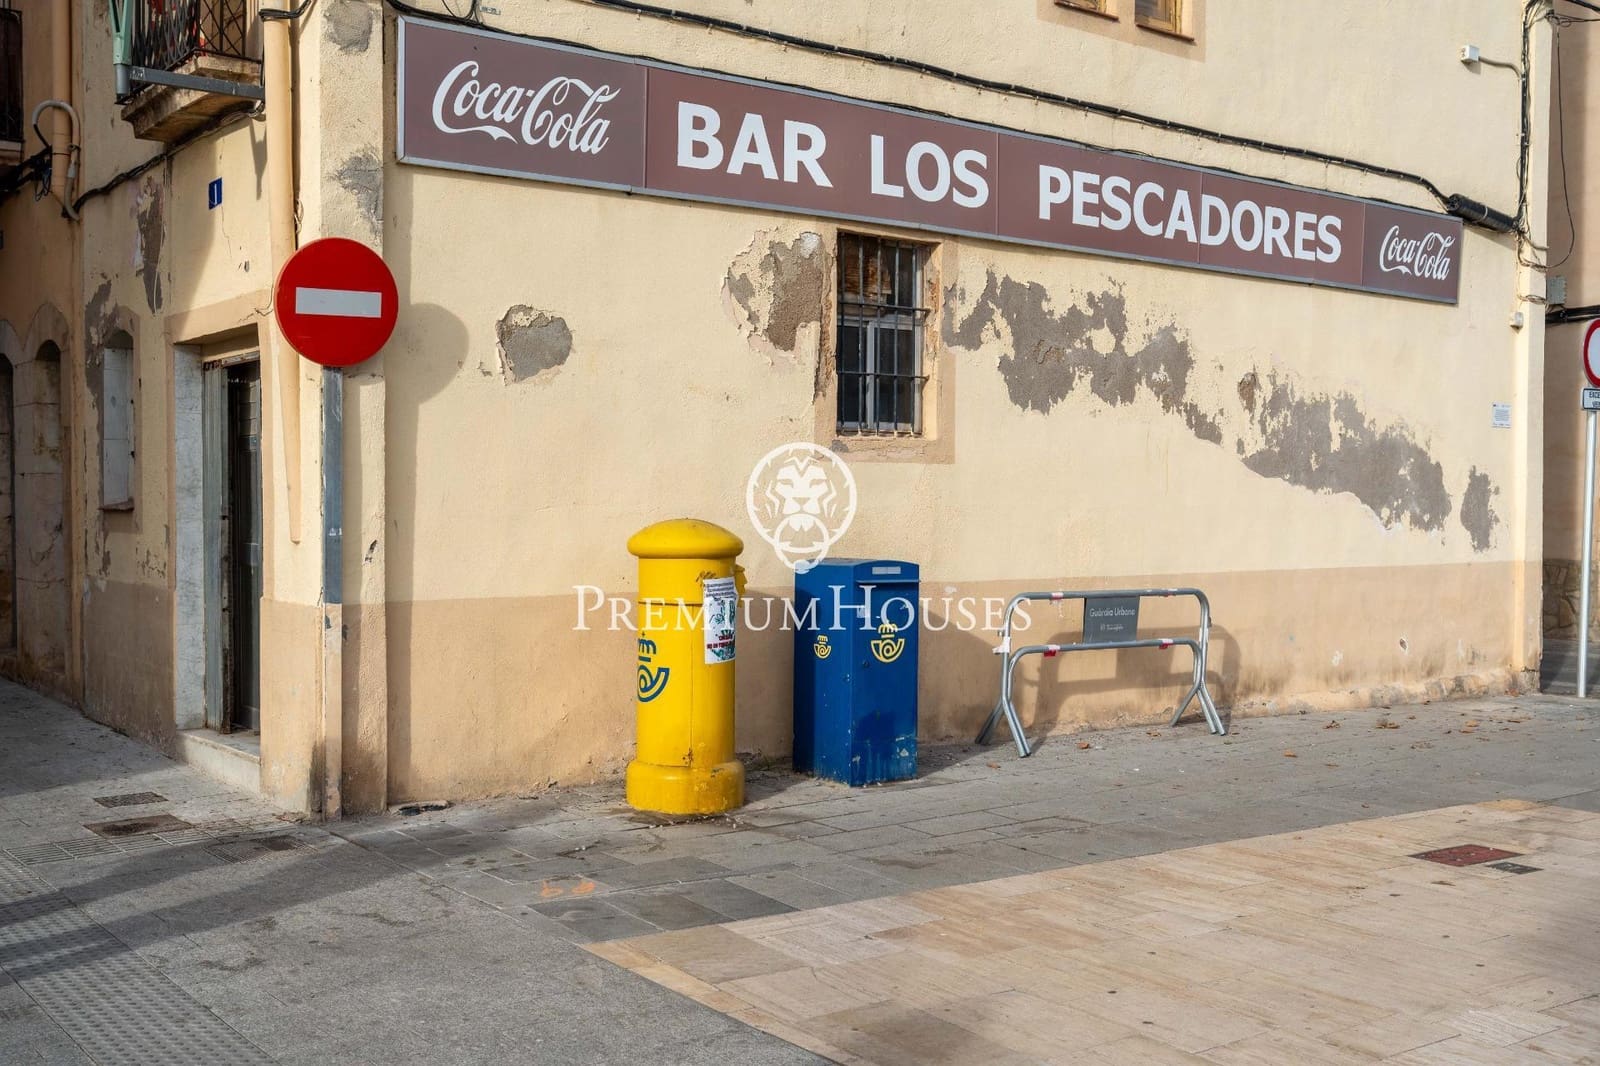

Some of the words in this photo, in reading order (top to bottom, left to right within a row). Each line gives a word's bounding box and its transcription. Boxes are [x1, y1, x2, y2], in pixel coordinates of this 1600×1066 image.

[432, 60, 621, 155] Coca-Cola
[677, 101, 833, 189] BAR
[870, 134, 989, 209] LOS
[1038, 164, 1342, 263] PESCADORES
